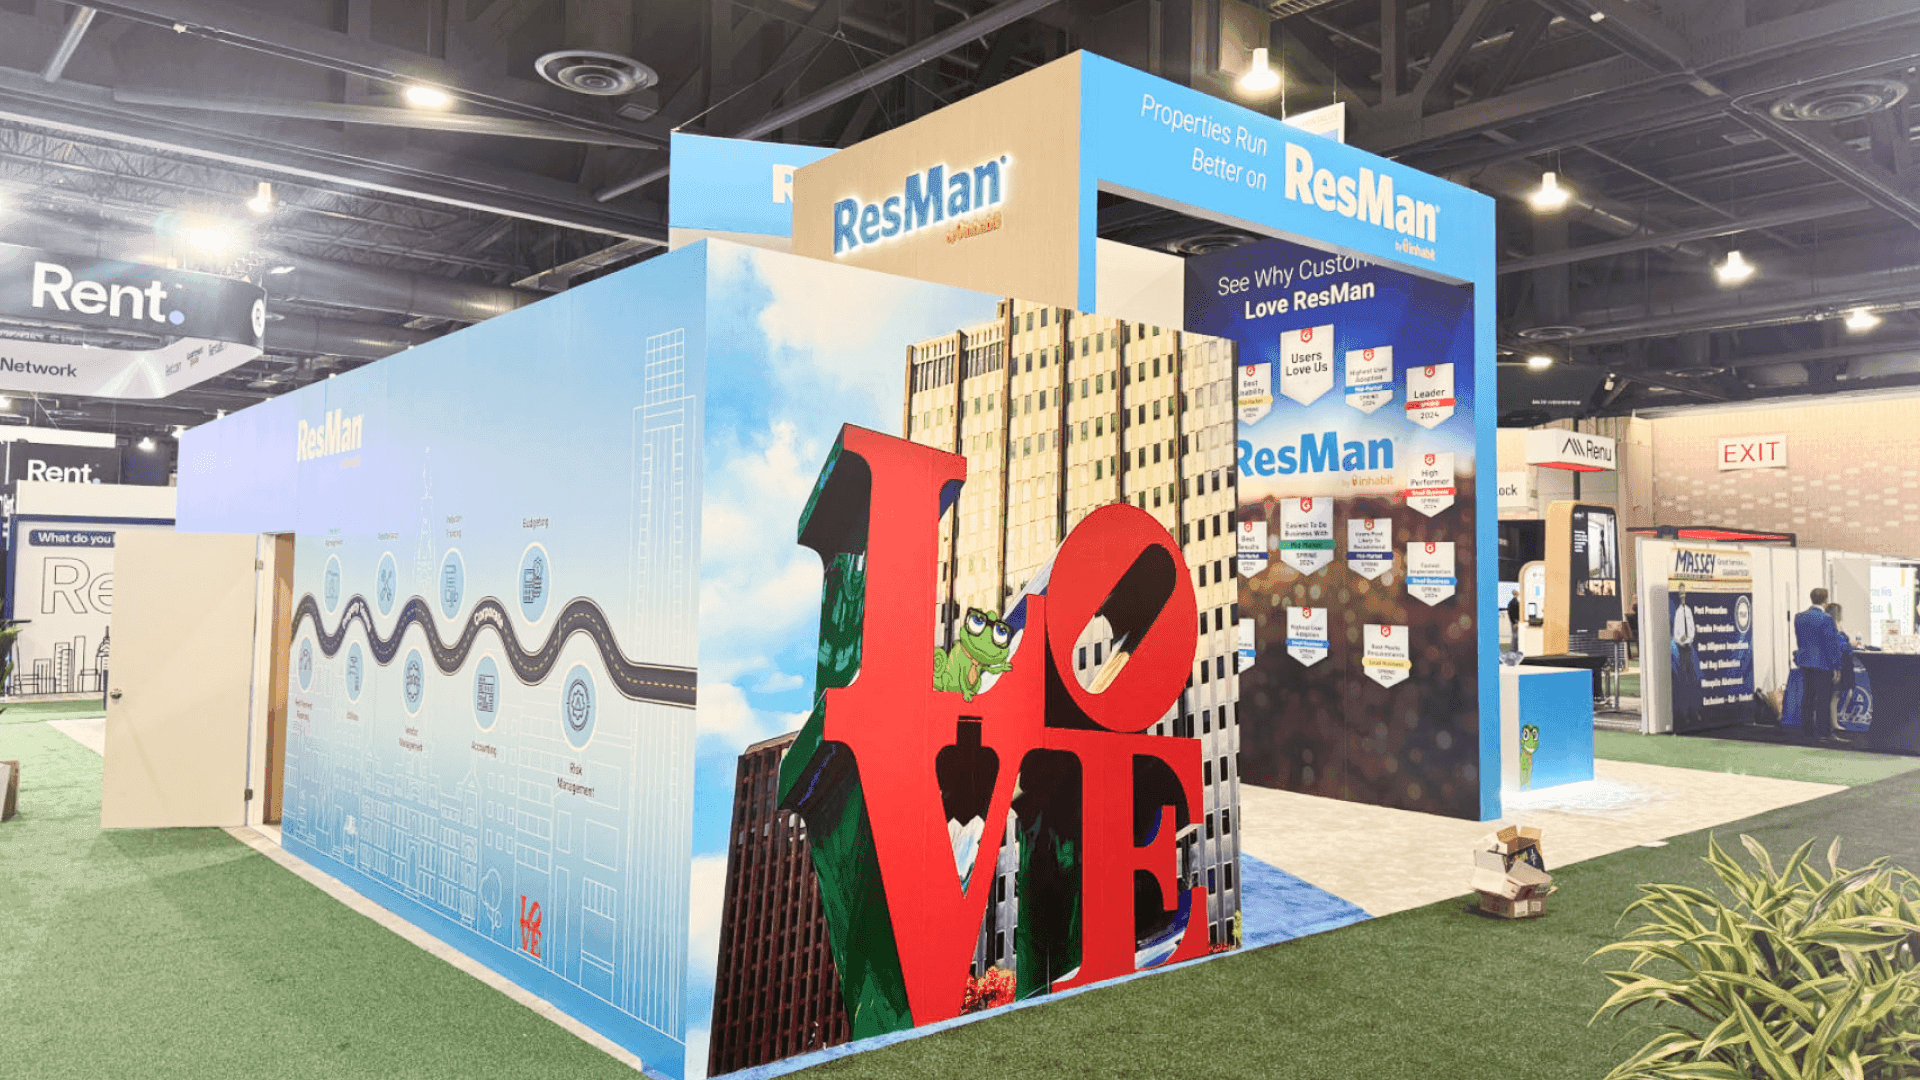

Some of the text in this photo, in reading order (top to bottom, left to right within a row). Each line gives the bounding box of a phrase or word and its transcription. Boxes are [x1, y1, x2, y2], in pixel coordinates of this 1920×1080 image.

[1141, 94, 1267, 155] Properties Run
[1192, 147, 1267, 191] Better on
[1285, 141, 1436, 243] ResMan
[833, 159, 1001, 256] ResMan
[1218, 276, 1250, 296] See
[1254, 265, 1294, 288] Why
[32, 260, 185, 325] Rent.
[1245, 281, 1375, 320] Love ResMan
[1, 357, 77, 378] Network
[1285, 362, 1328, 376] Love Us
[1291, 352, 1322, 364] Users
[1414, 389, 1446, 399] Leader
[1420, 411, 1440, 419] 2024
[297, 408, 363, 463] ResMan
[1238, 431, 1394, 477] ResMan
[1586, 440, 1612, 462] Renu
[1724, 441, 1780, 463] EXIT
[1358, 475, 1394, 486] inhabit
[1410, 478, 1450, 487] Performer
[1421, 469, 1438, 478] High
[38, 532, 111, 546] What do you
[1675, 549, 1717, 574] MASSEY
[569, 762, 583, 776] Risk
[557, 777, 595, 798] Management
